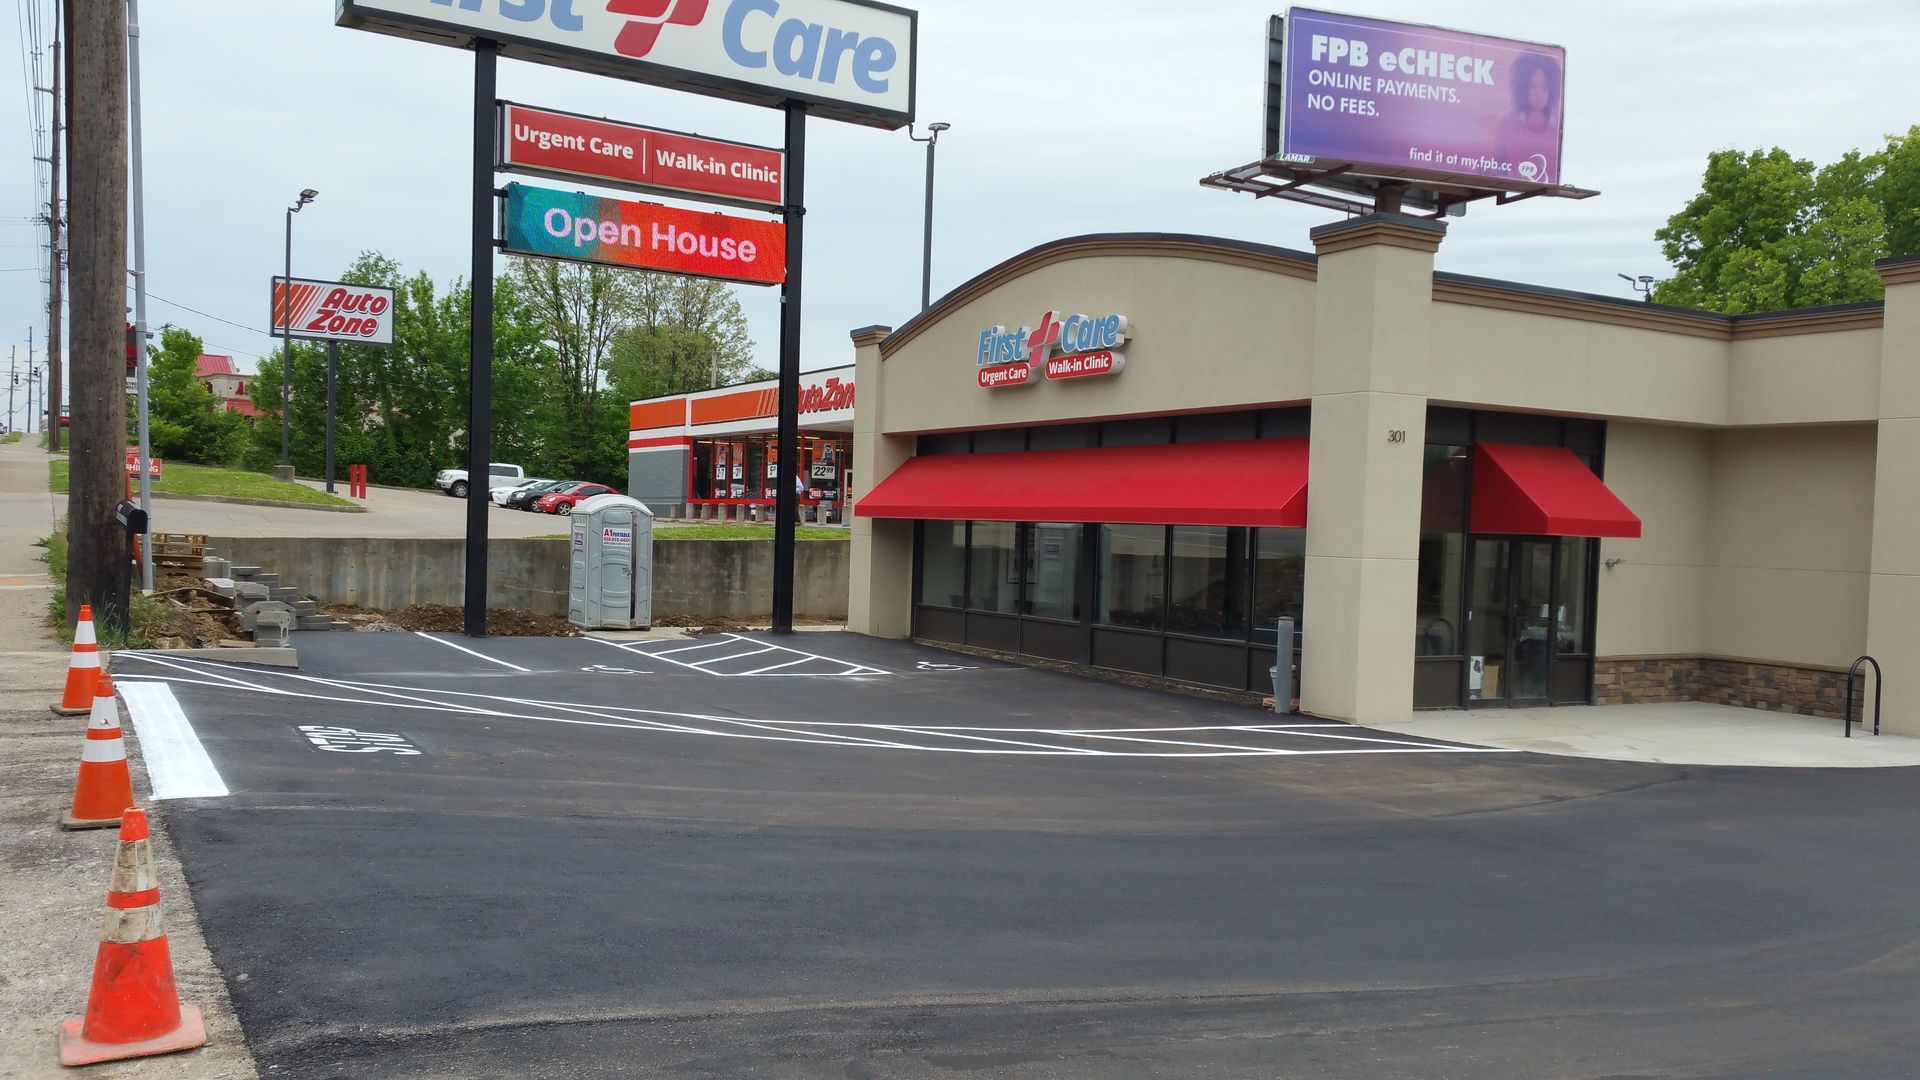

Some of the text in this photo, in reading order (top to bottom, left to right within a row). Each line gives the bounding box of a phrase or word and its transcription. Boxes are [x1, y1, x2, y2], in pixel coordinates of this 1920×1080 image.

[722, 0, 897, 94] Care
[1312, 34, 1495, 86] FPB eCHECK
[1309, 69, 1460, 103] ONLINE PAYMENTS.
[1308, 93, 1379, 116] NO FEES.
[514, 123, 634, 159] Urgent Care
[656, 149, 778, 183] Walk-in Clinic
[1280, 153, 1310, 163] LAMAR
[1409, 147, 1512, 171] find it at my.fpb.cc
[544, 208, 757, 262] Open House
[321, 288, 388, 315] Auto
[306, 309, 378, 337] Zone
[977, 314, 1120, 366] First Care
[981, 367, 1027, 385] Urgent Care
[1048, 354, 1109, 374] Walk-in Clinic
[798, 377, 855, 415] utoZon
[1388, 430, 1405, 443] 301
